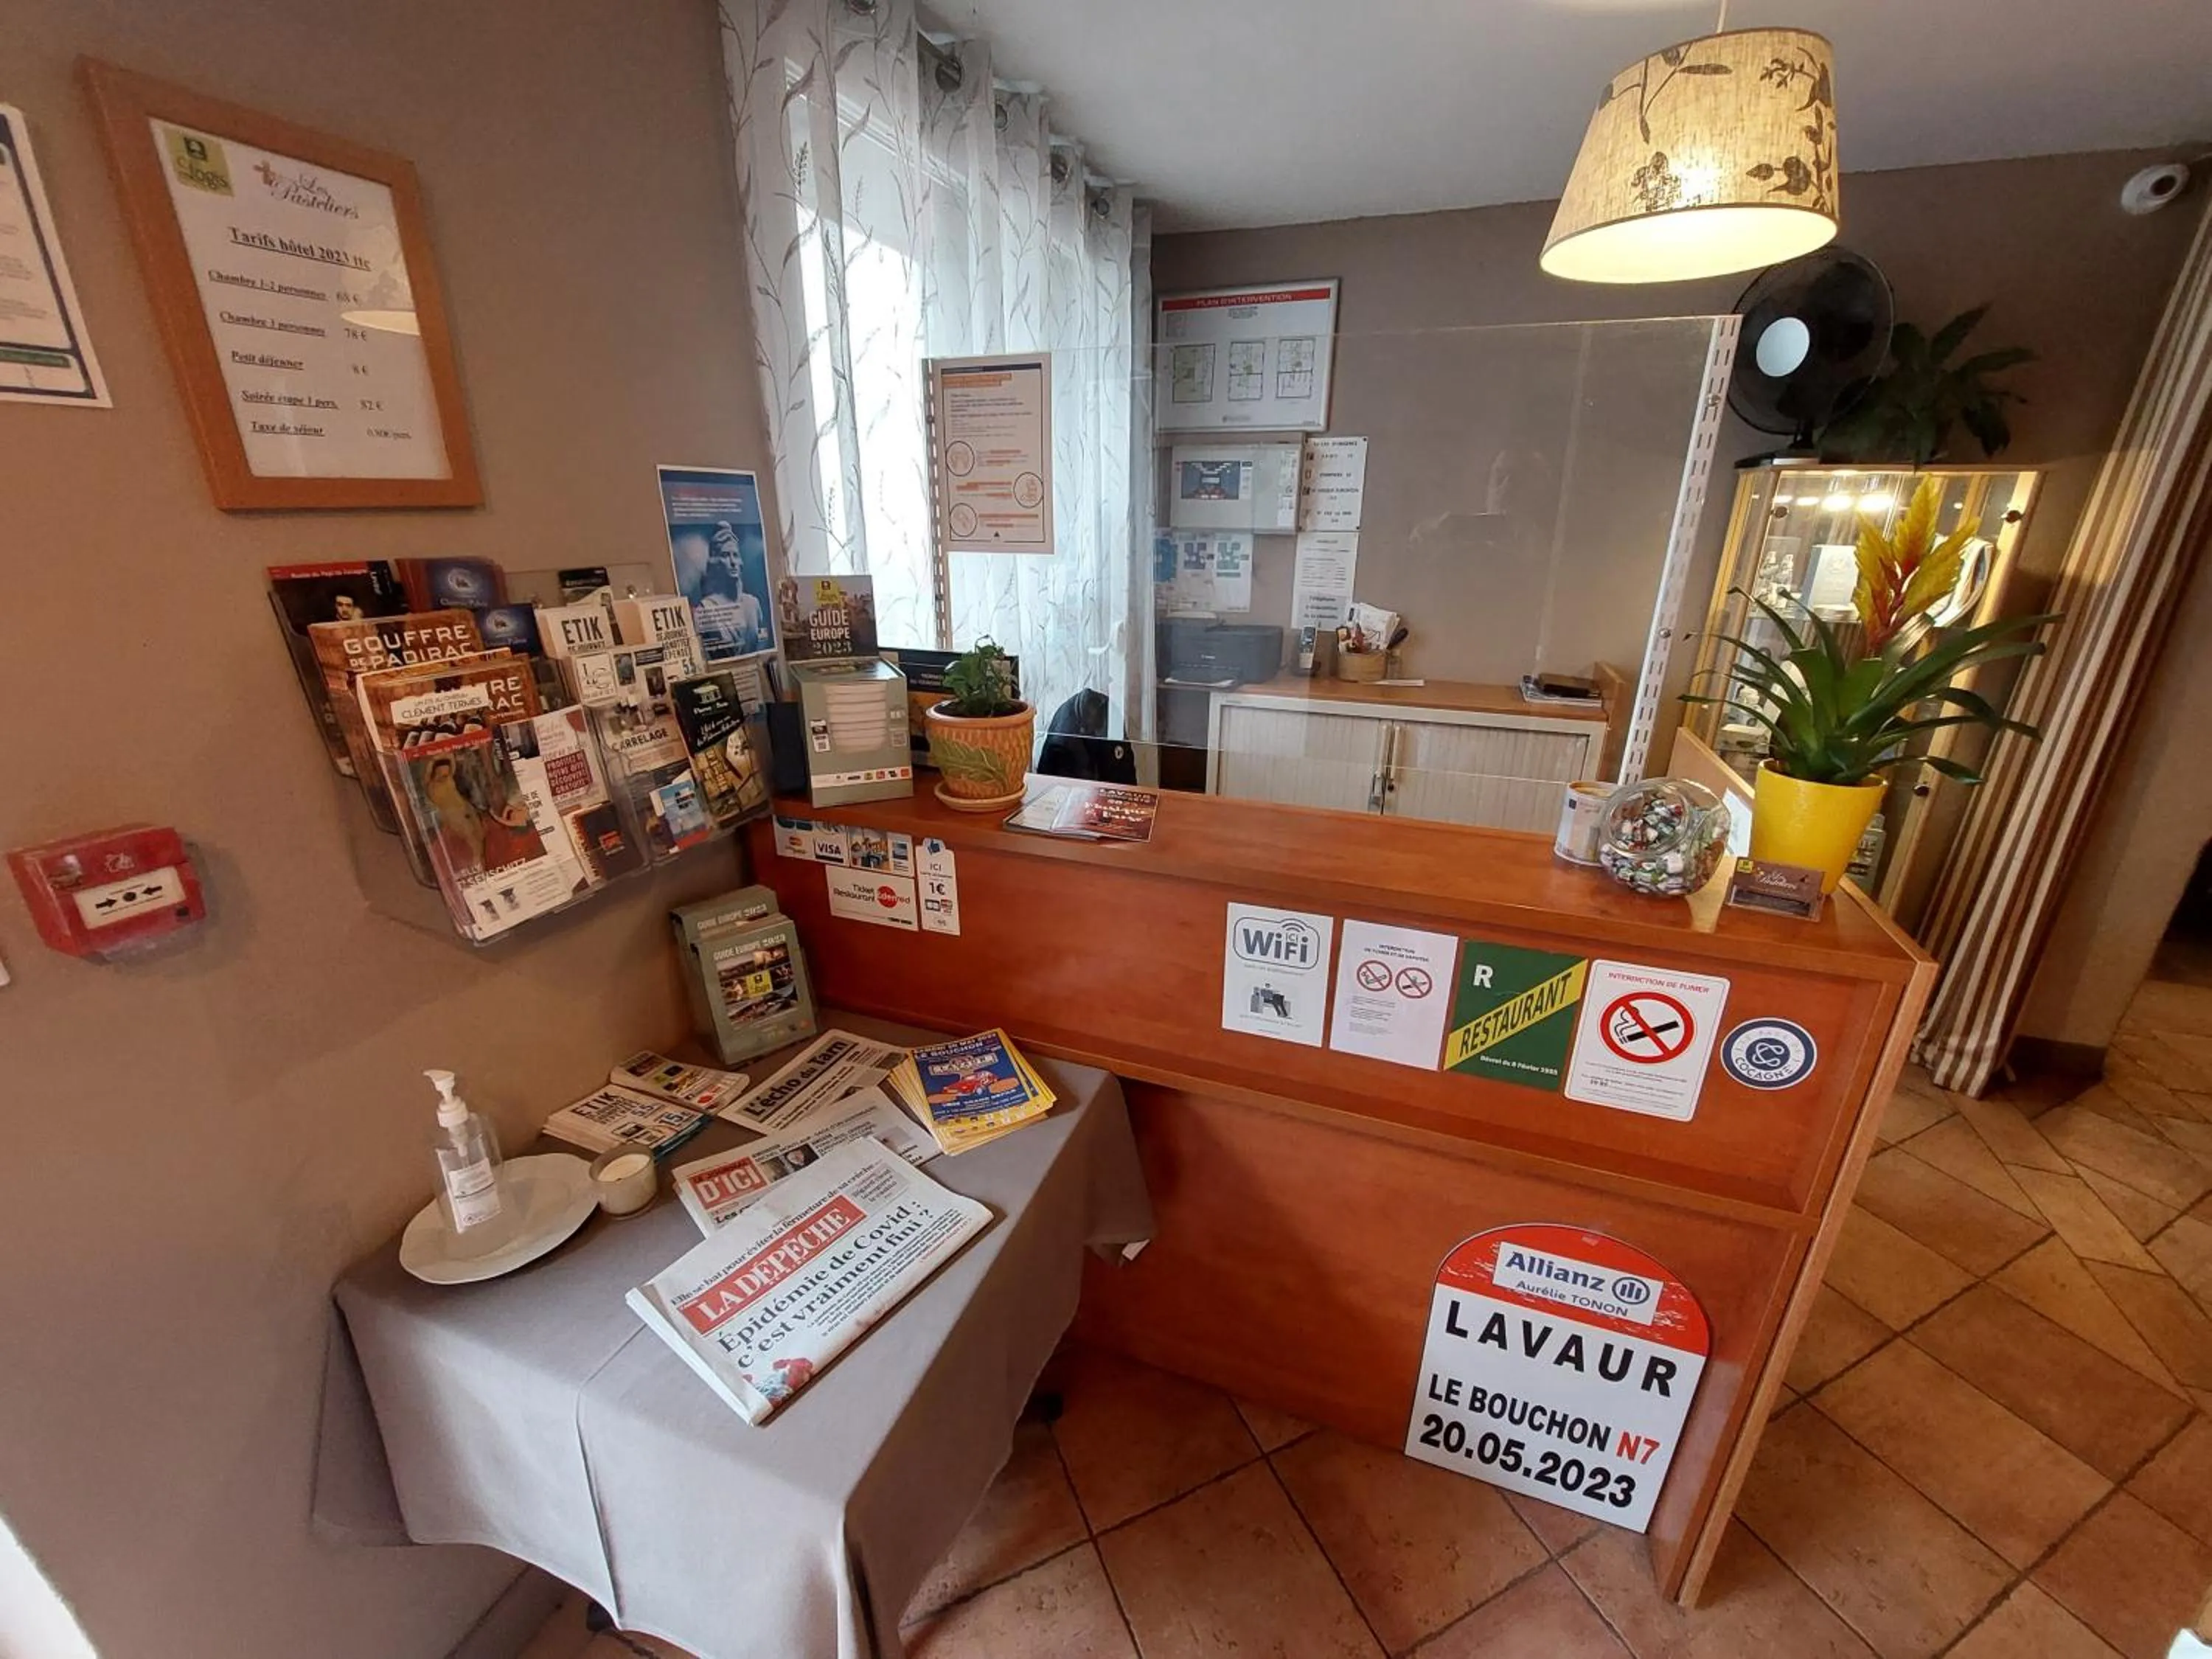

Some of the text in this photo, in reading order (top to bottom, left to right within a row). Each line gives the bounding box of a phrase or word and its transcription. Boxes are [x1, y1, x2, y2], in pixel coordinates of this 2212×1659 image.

[228, 226, 276, 249] Tarifs
[279, 236, 316, 258] hôtel
[208, 268, 256, 287] Chambre
[1196, 298, 1219, 307] PLAN
[220, 310, 267, 327] Chambre
[231, 349, 257, 364] Petit
[251, 420, 276, 434] Taxe
[560, 616, 605, 645] ETIK
[651, 605, 686, 631] ETIK
[809, 608, 849, 627] GUIDE
[343, 625, 470, 655] GOUFFRE
[810, 625, 850, 641] EUROPE
[367, 642, 474, 671] PADIRAC
[811, 639, 853, 655] 2023
[612, 727, 669, 753] CARRELAGE
[817, 842, 842, 856] VISA
[929, 863, 943, 872] ICI
[833, 887, 876, 903] Restaurant
[852, 884, 875, 894] Ticket
[928, 881, 947, 897] 1€
[1242, 928, 1309, 963] WiFi
[1472, 963, 1494, 989] R
[1608, 971, 1711, 995] INTERDICTION DE FUMER
[1459, 972, 1572, 1057] RESTAURANT
[743, 1078, 799, 1117] L'écho
[807, 1040, 849, 1065] Tarn
[1735, 1057, 1792, 1081] COCAGNE
[570, 1091, 617, 1117] ETIK
[695, 1163, 762, 1205] D'ICI
[722, 1254, 748, 1279] pour
[781, 1196, 829, 1236] fermeture
[696, 1284, 742, 1323] LA
[734, 1207, 850, 1296] DÉPÊCHE
[1506, 1251, 1606, 1292] Allianz
[718, 1268, 830, 1354] Épidémie
[829, 1249, 856, 1271] de
[853, 1205, 911, 1250] Covid
[737, 1318, 803, 1369] c'est
[793, 1245, 891, 1322] vraiment
[886, 1219, 924, 1248] fini
[1515, 1279, 1630, 1318] Aurélie TONON
[1445, 1300, 1678, 1398] LAVAUR
[1428, 1374, 1660, 1465] LE BOUCHON N7
[1419, 1413, 1637, 1509] 20.05.2023
